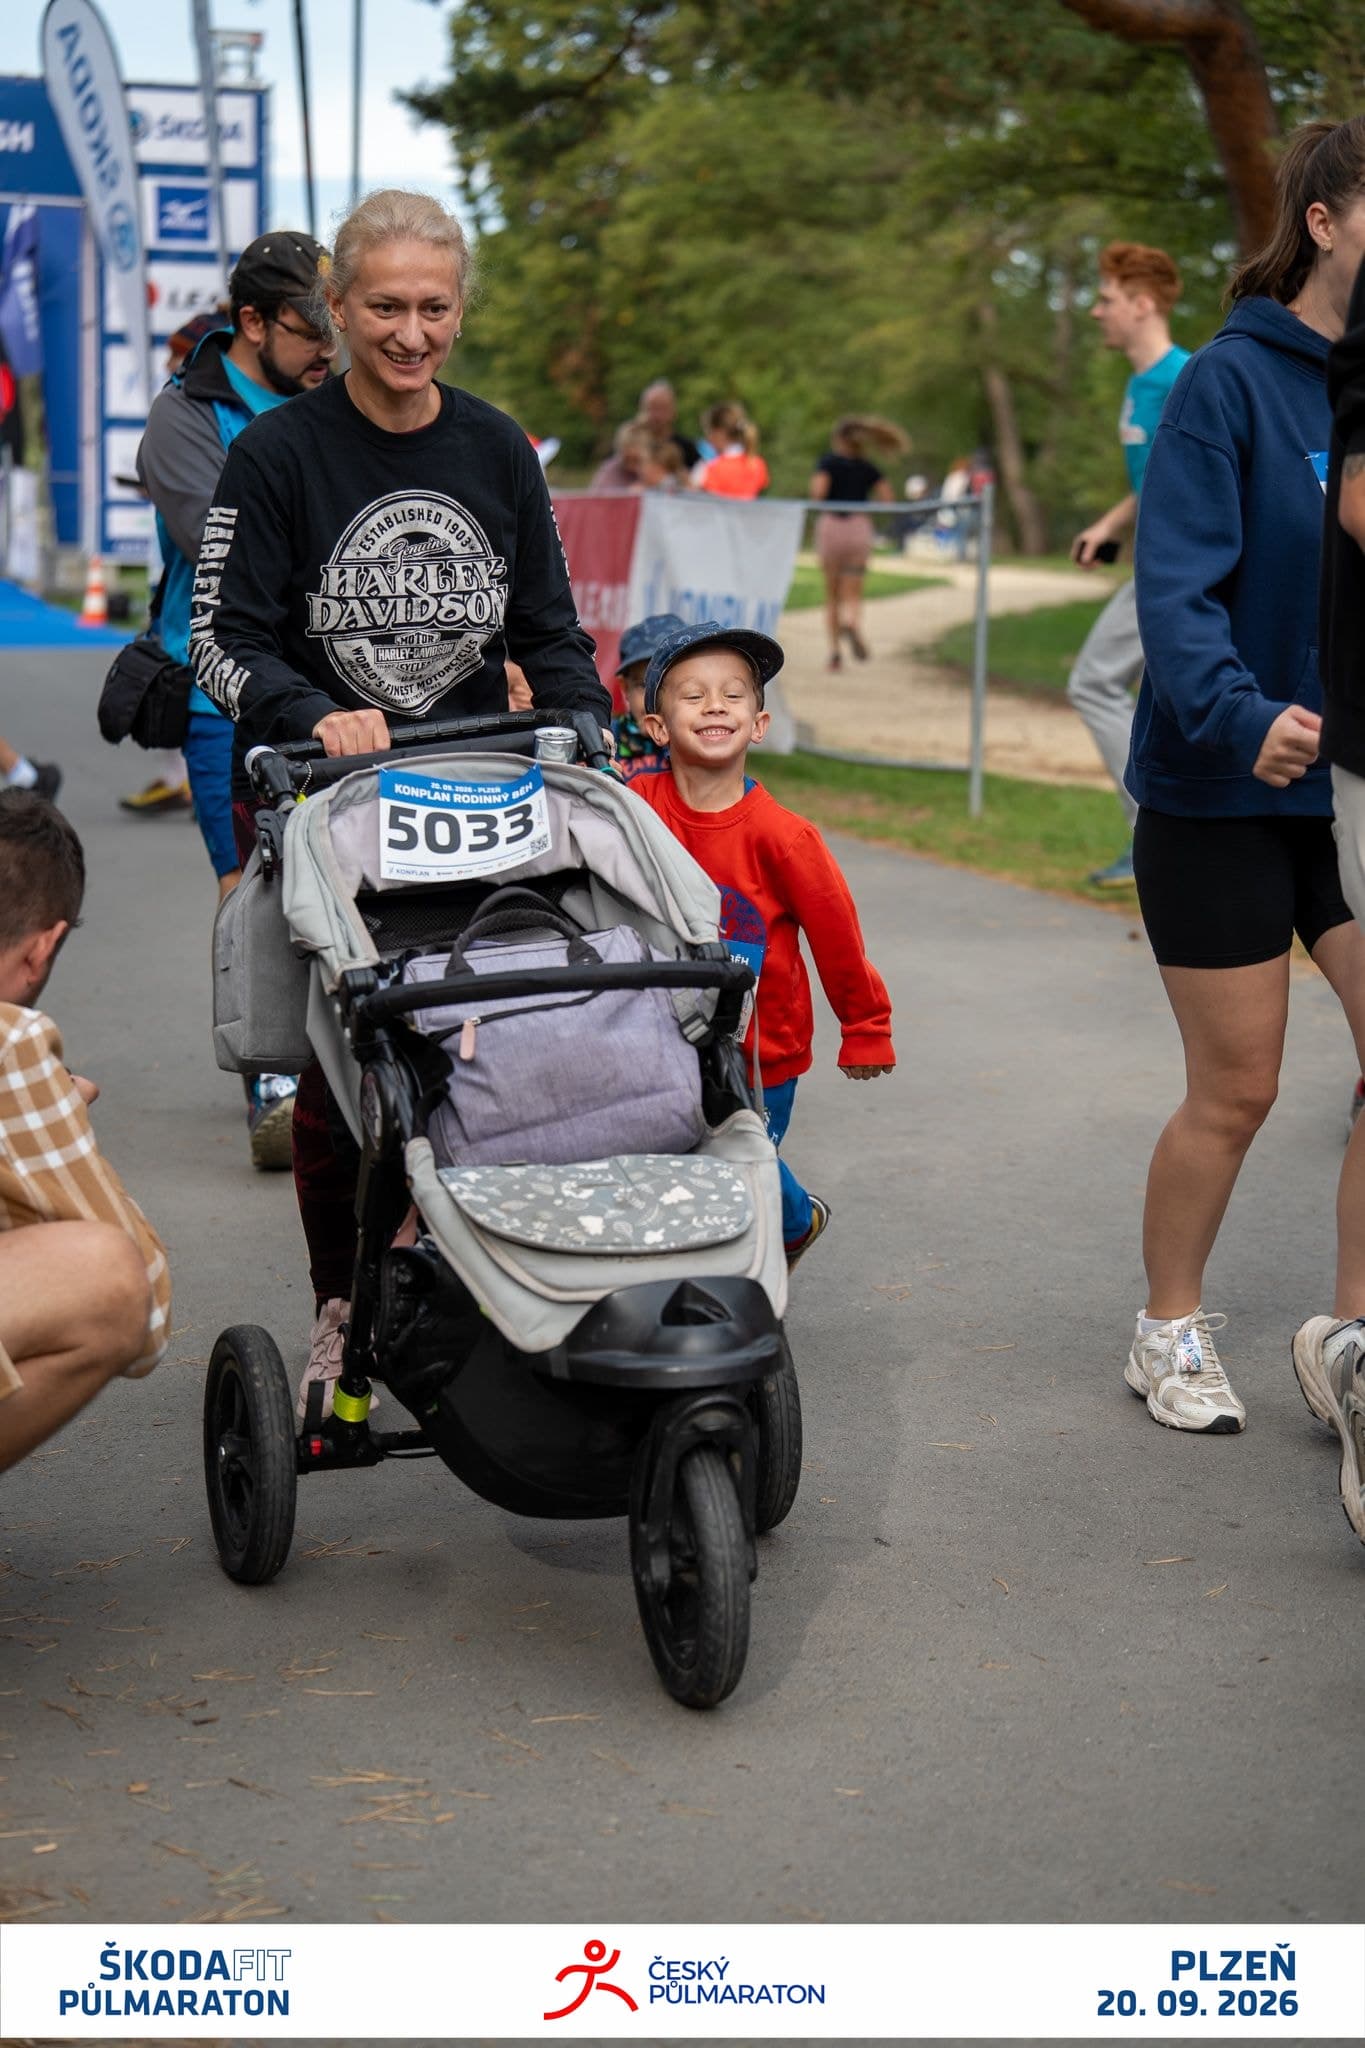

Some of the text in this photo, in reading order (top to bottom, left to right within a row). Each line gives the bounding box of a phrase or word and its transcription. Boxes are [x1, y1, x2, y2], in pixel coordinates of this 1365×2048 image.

[359, 508, 471, 552] ESTABLISHED 1903
[380, 537, 450, 570] Genuine
[306, 584, 508, 637] DAVIDSON
[377, 643, 455, 661] HARLEY-DAVIDSON
[400, 631, 435, 645] MOTOR
[351, 639, 478, 697] WORLD'S FINEST MOTORCYCLES
[394, 782, 533, 804] KONPLAN RODINNÝ BĚH
[387, 803, 534, 855] 5033
